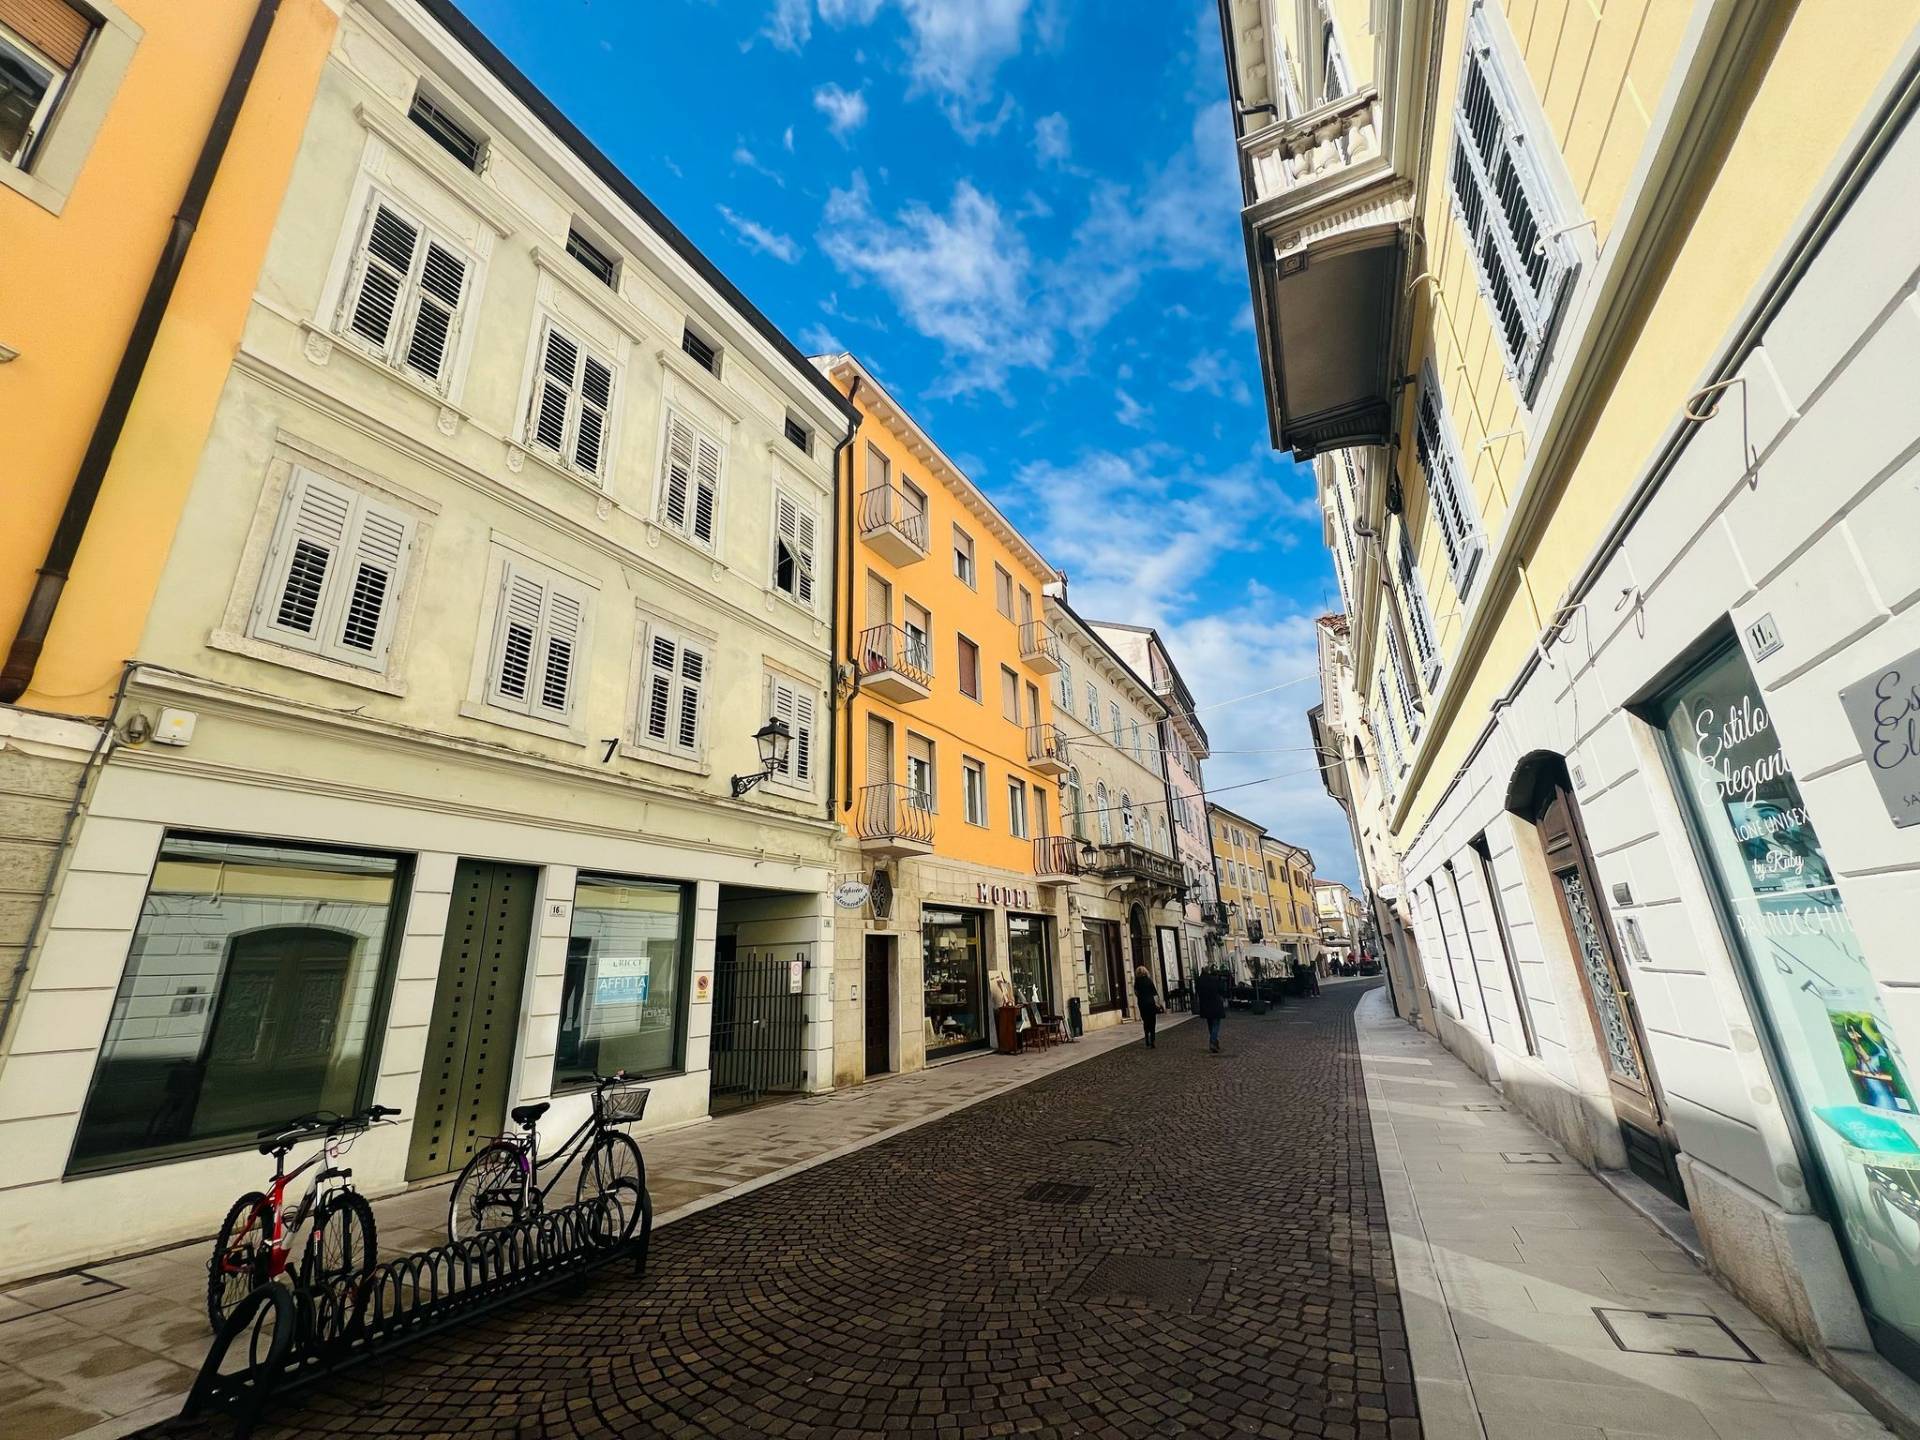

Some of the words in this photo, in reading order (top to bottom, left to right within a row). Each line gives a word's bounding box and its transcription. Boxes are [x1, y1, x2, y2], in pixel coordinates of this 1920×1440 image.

[1696, 695, 1769, 763] Estilo
[1764, 807, 1812, 833] UNISEX
[1752, 859, 1766, 880] by
[1766, 850, 1804, 875] Ruby
[977, 882, 1033, 909] MODEL
